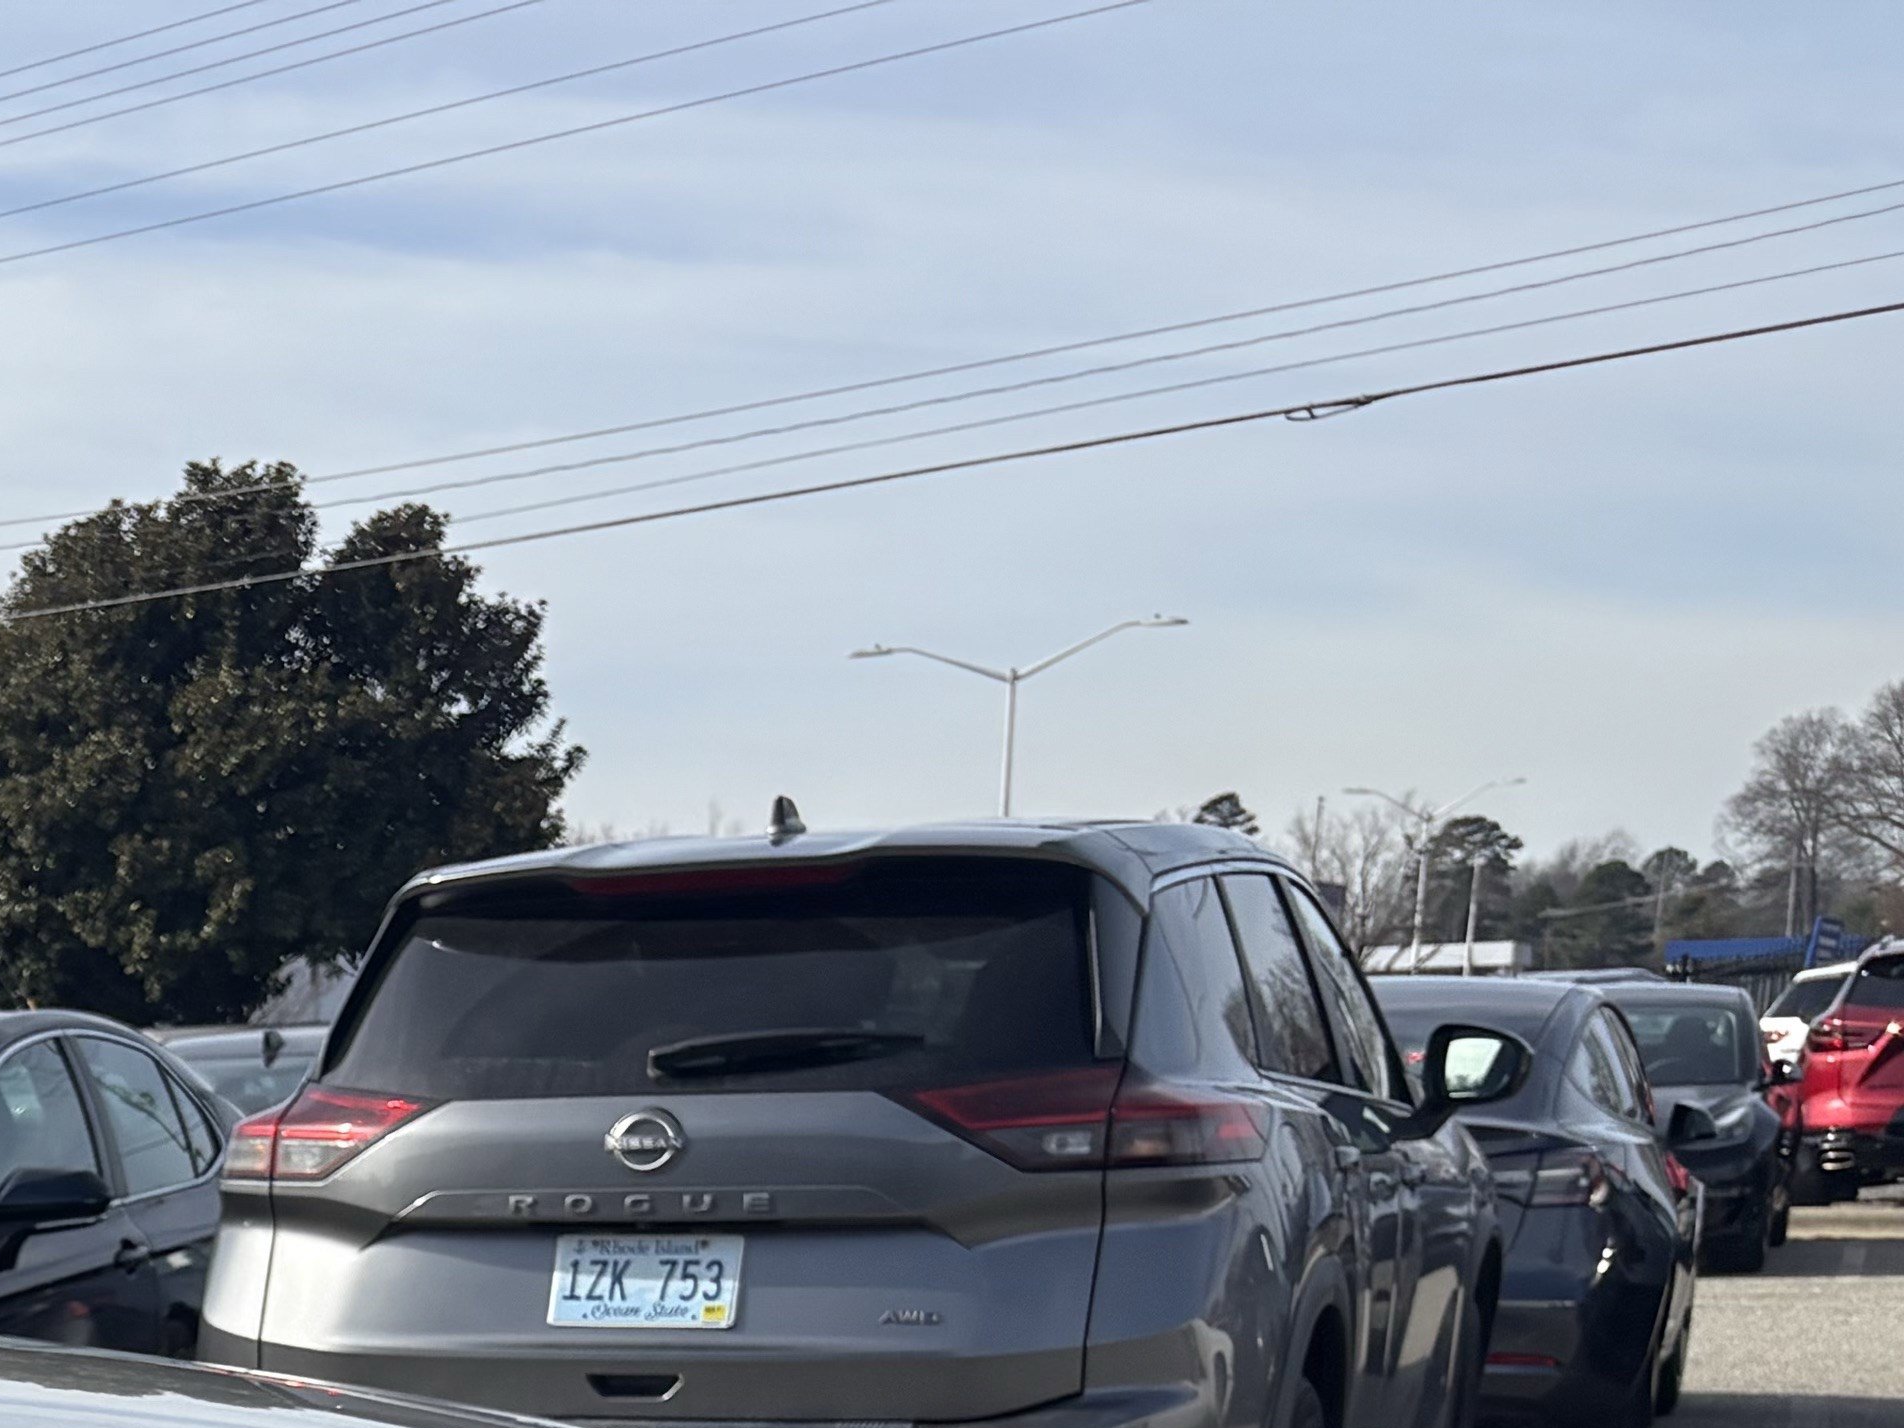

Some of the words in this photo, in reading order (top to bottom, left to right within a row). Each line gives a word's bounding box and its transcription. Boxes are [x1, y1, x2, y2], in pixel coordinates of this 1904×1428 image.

[604, 1133, 684, 1151] NISSAN
[508, 1191, 771, 1216] ROGUE
[562, 1258, 631, 1301] 1ZK
[659, 1258, 724, 1301] 753
[879, 1309, 941, 1326] AWD
